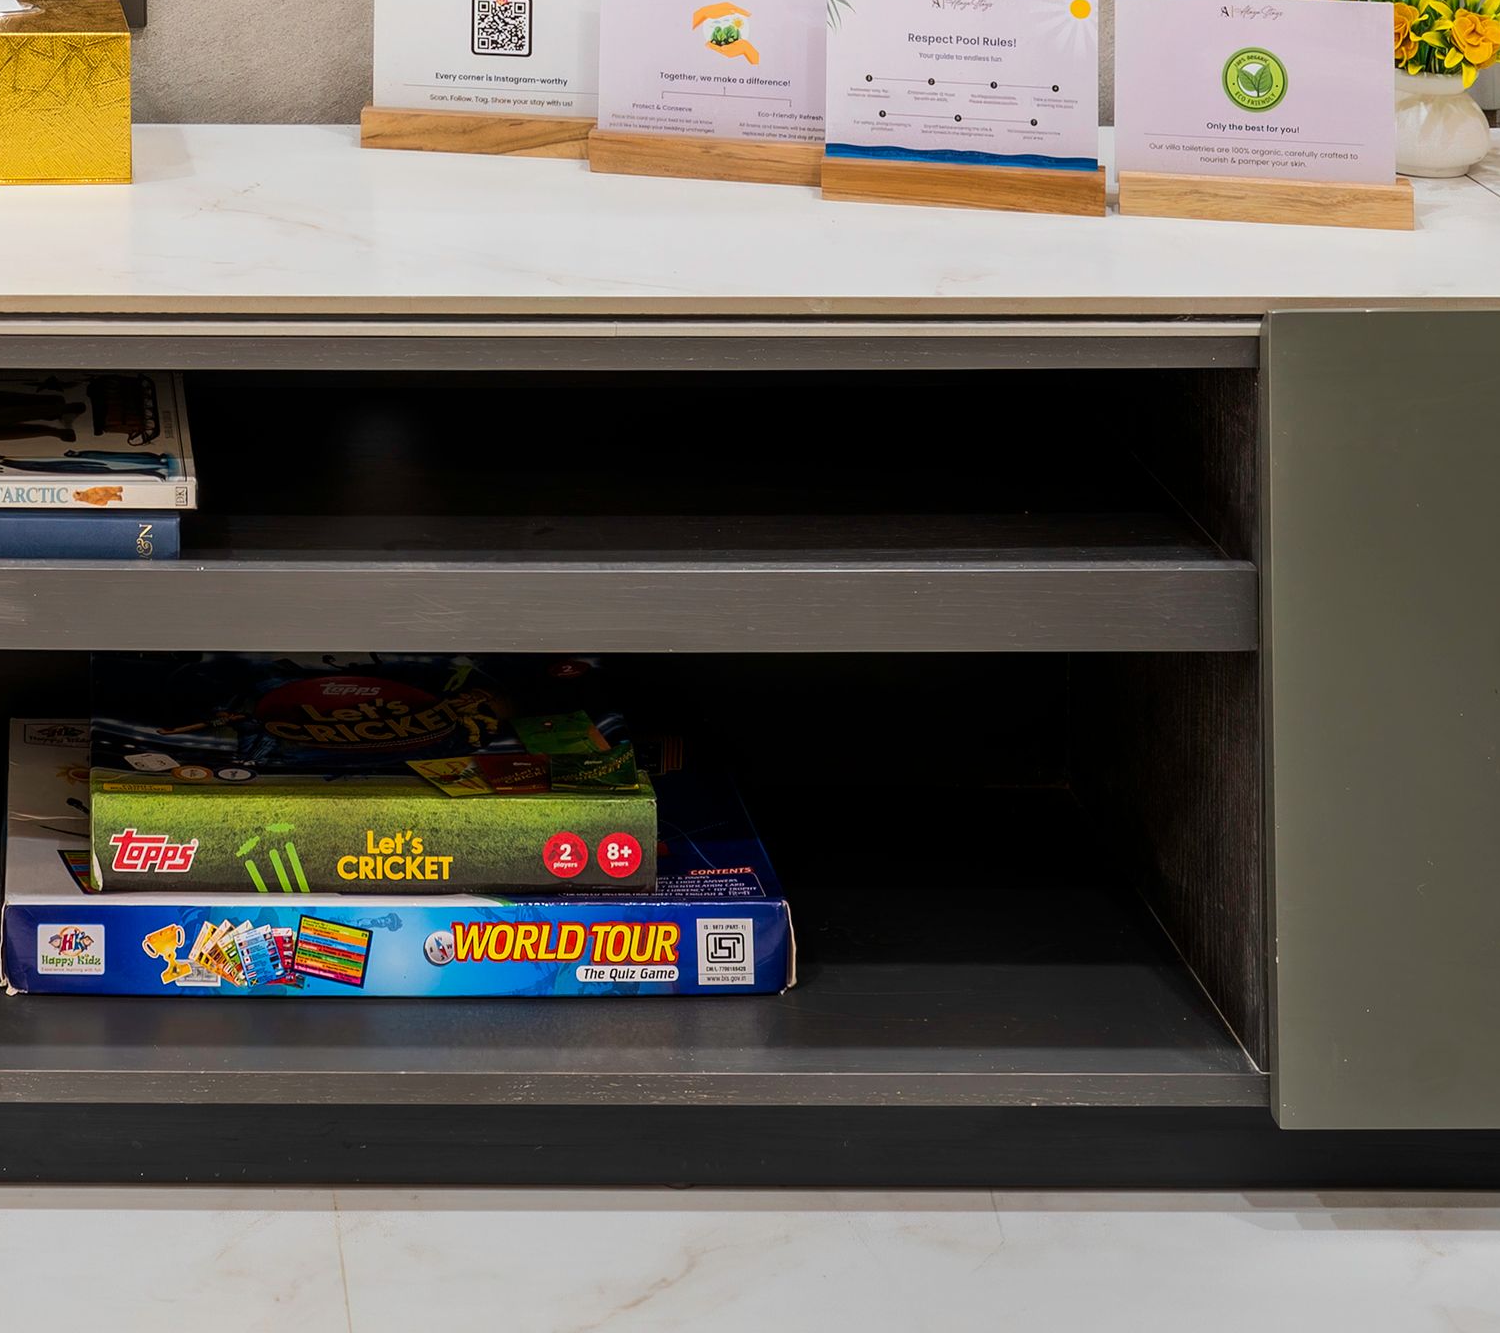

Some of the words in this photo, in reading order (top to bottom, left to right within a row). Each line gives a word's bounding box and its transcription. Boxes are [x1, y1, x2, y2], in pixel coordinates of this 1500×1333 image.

[907, 32, 953, 47] Respect
[955, 35, 980, 46] Pool
[982, 36, 1017, 48] Rules!
[918, 51, 934, 60] Your
[935, 52, 954, 62] guide
[963, 54, 989, 62] endless
[435, 71, 457, 82] Every
[458, 74, 484, 82] corner
[485, 73, 492, 82] is
[493, 74, 568, 87] Instagram-worthy
[659, 71, 698, 83] Together,
[713, 75, 737, 84] make
[746, 76, 791, 87] difference!
[491, 96, 511, 104] Share
[512, 98, 528, 107] your
[529, 98, 545, 107] stay
[546, 99, 561, 107] with
[632, 102, 655, 110] Protect
[662, 104, 692, 112] Conserve
[758, 110, 798, 121] Eco-Friendly
[799, 113, 824, 121] Refresh
[1206, 121, 1227, 133] Only
[1228, 123, 1243, 132] the
[1245, 124, 1264, 132] best
[1265, 124, 1278, 133] for
[1280, 125, 1300, 135] you!
[1149, 142, 1163, 151] Our
[1165, 143, 1181, 151] villa
[1182, 144, 1215, 154] toiletries
[1231, 146, 1249, 155] 100%
[1284, 149, 1318, 160] carefully
[1320, 150, 1348, 160] crafted
[1350, 152, 1359, 160] to
[1200, 154, 1229, 164] nourish
[1230, 156, 1237, 164] &
[1238, 157, 1270, 167] pamper
[1271, 159, 1289, 168] your
[301, 698, 411, 723] Let's
[264, 699, 463, 743] CRICKET
[366, 830, 424, 856] Let's
[560, 843, 572, 861] 2
[606, 843, 633, 862] 8+
[337, 855, 454, 881] CRICKET
[553, 861, 578, 870] players
[610, 861, 629, 869] years
[690, 866, 752, 876] CONTENTS
[453, 923, 585, 961] WORLD
[591, 924, 677, 962] TOUR
[41, 954, 75, 967] Happy
[77, 953, 101, 966] Kidz
[583, 968, 606, 980] The
[610, 968, 636, 981] Quiz
[640, 968, 675, 980] Game
